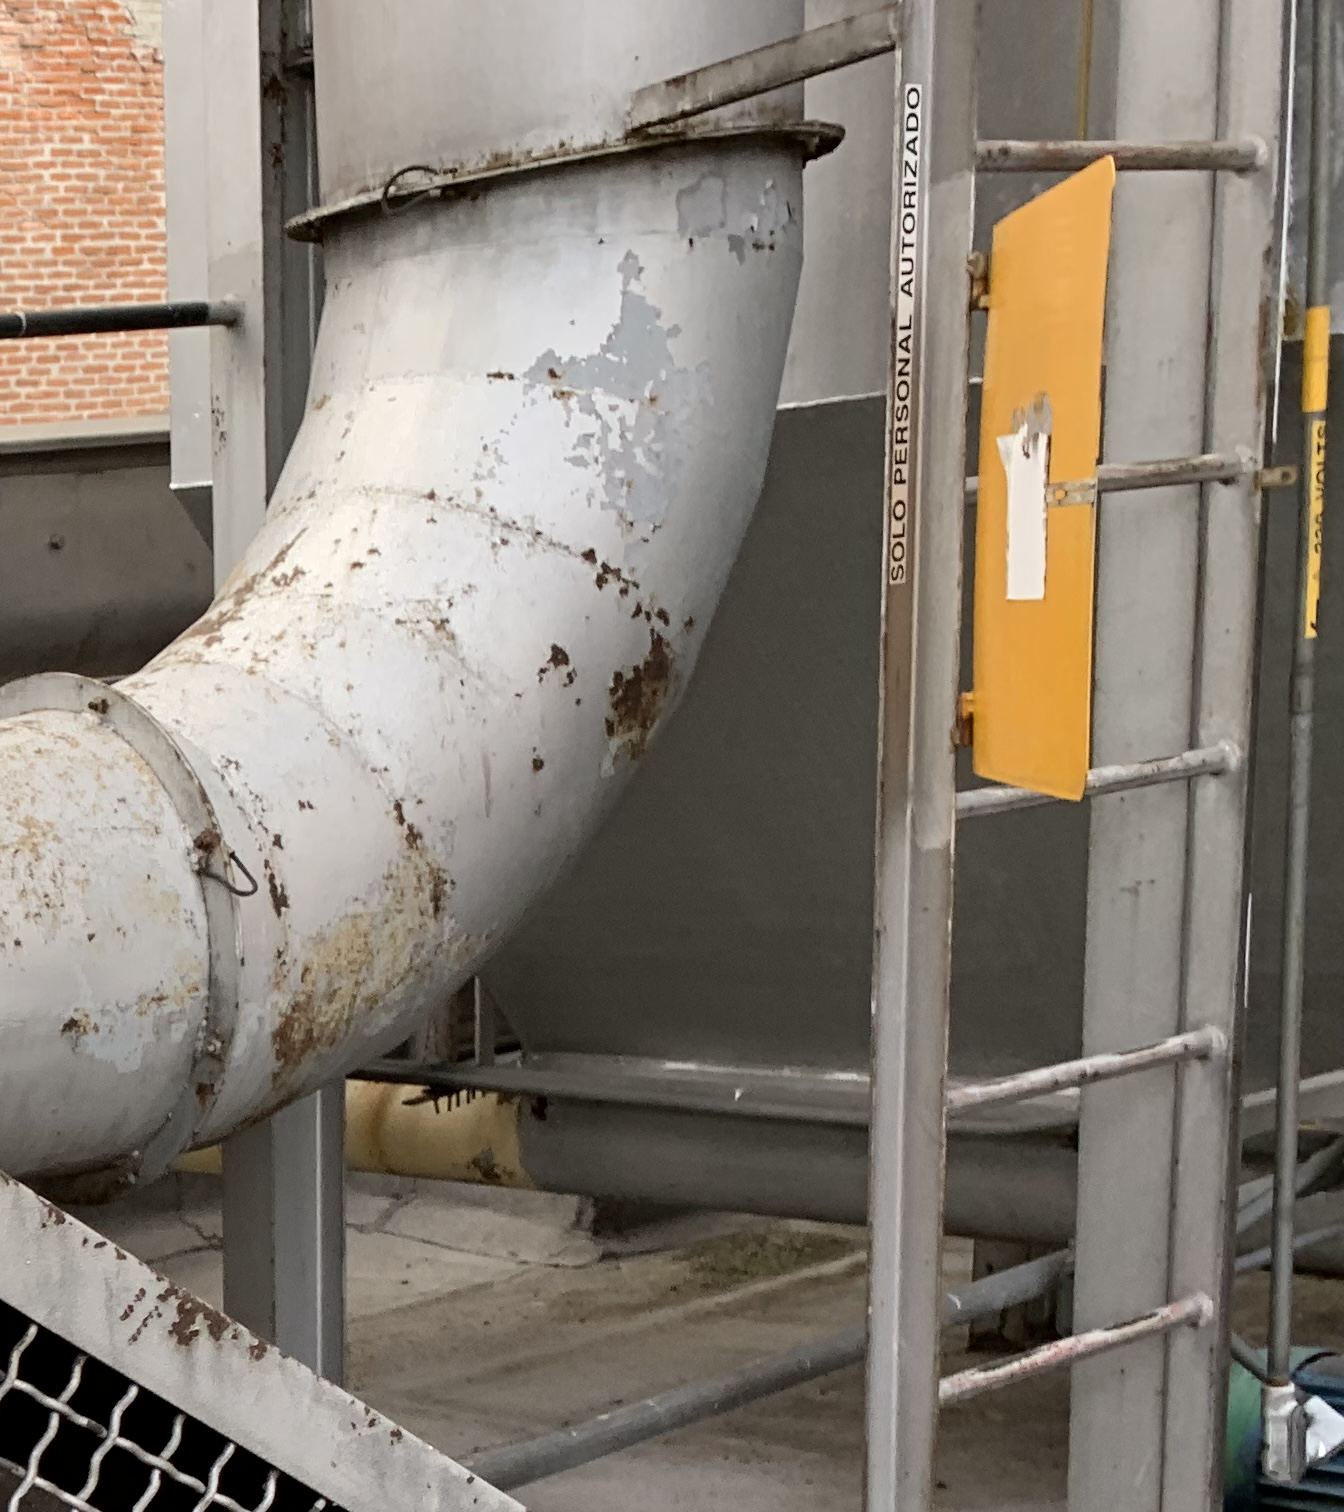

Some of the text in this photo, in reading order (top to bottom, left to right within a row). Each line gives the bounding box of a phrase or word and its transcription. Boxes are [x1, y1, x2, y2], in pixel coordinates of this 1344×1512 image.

[891, 86, 921, 582] SOLO PERSONAL AUTORIZADO
